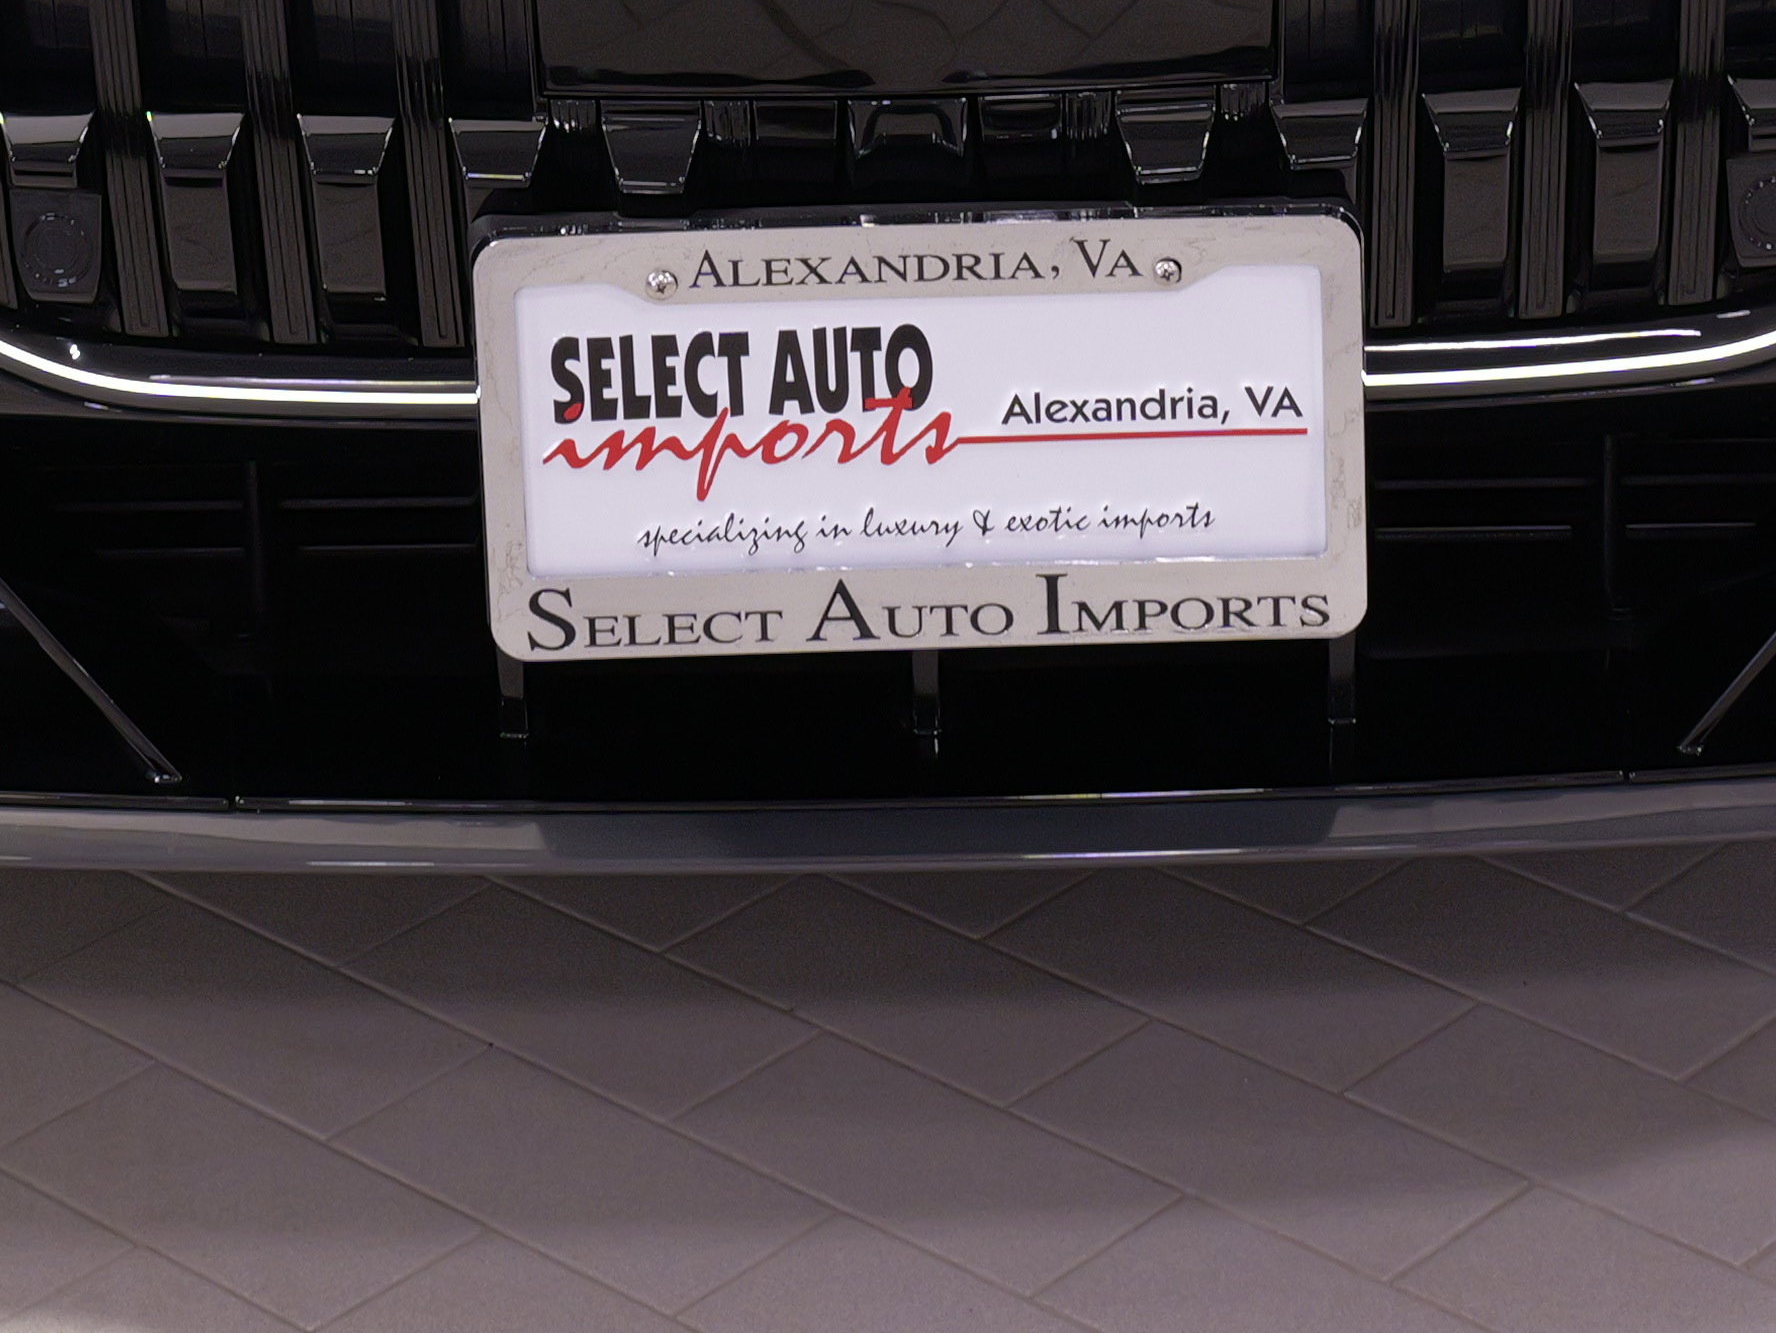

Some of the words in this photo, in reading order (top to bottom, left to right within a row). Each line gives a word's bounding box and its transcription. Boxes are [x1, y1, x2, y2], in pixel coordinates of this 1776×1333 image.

[689, 248, 1060, 289] ALEXANDRIA,
[1069, 237, 1144, 278] VA
[550, 330, 750, 425] SELECT
[769, 323, 933, 415] AUTO
[1001, 387, 1230, 425] Alexandria,
[1244, 386, 1304, 418] VA
[542, 386, 960, 502] imports
[637, 512, 807, 557] specializing
[815, 515, 853, 539] in
[860, 506, 964, 548] luxury
[972, 508, 996, 537] &
[1004, 505, 1091, 534] exotic
[1098, 501, 1217, 539] imports
[527, 587, 784, 652] SELECT
[805, 578, 1015, 642] AUTO
[1035, 572, 1331, 635] IMPORTS
